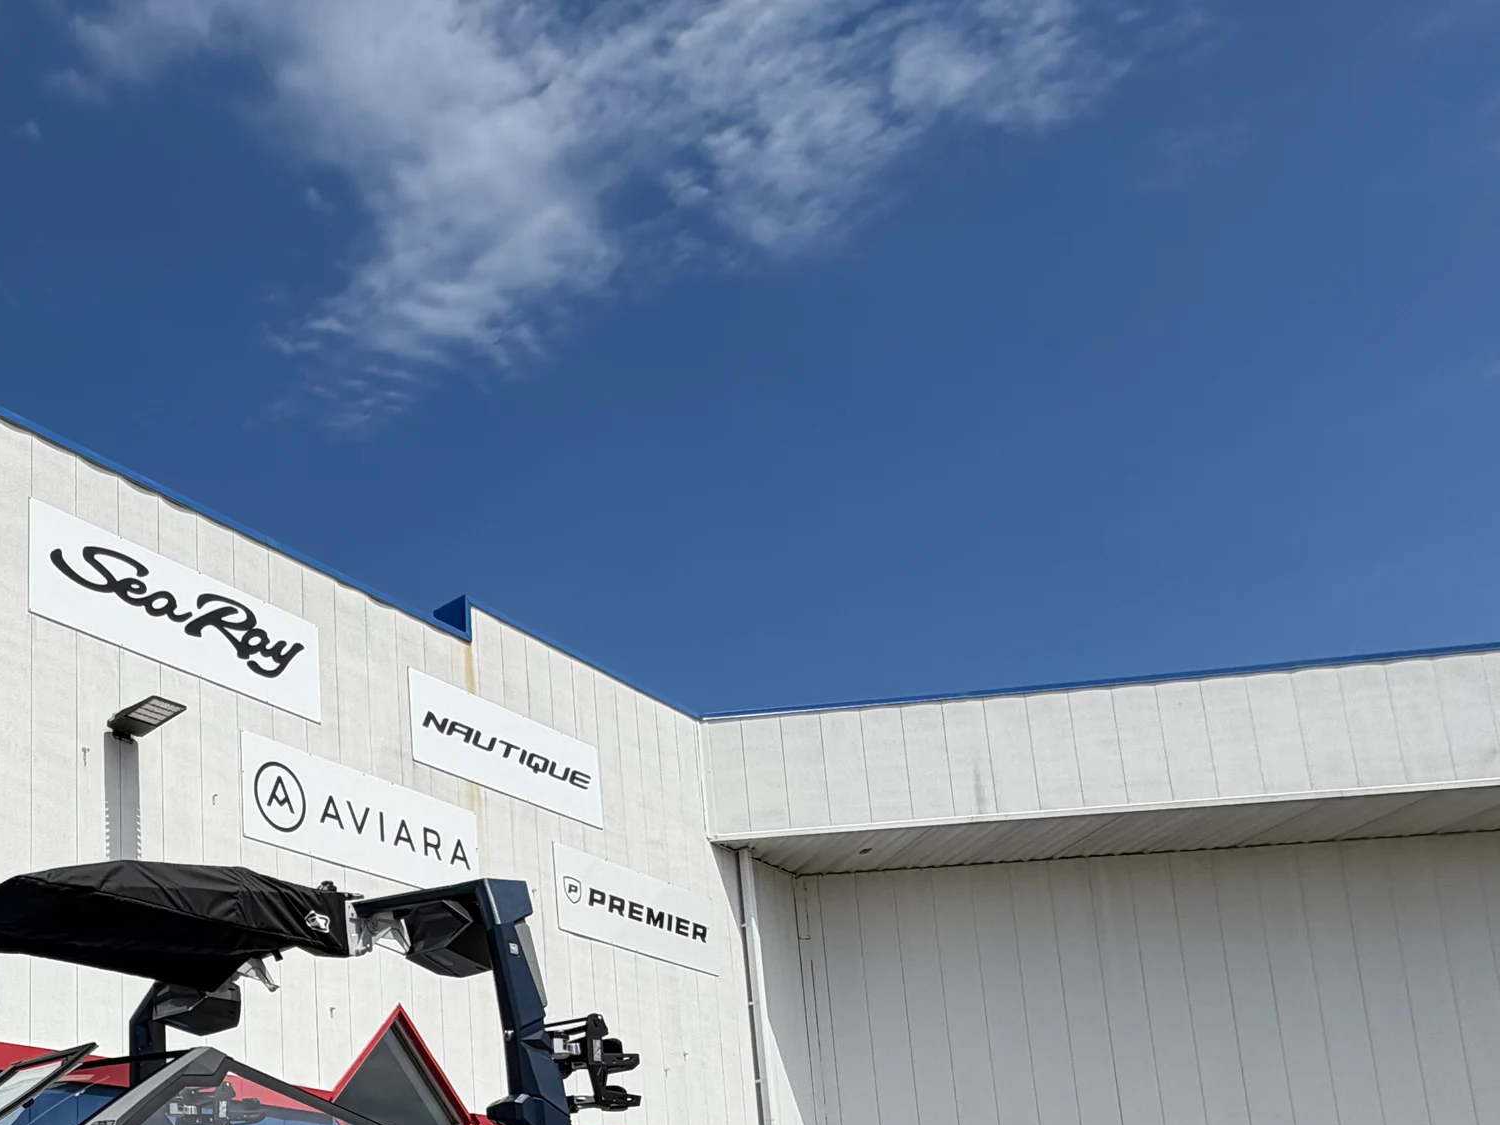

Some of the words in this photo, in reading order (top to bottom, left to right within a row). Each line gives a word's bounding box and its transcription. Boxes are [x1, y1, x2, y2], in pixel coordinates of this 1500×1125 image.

[50, 546, 193, 623] Sea
[184, 593, 305, 679] Ray
[422, 711, 591, 790] NAUTIQUE
[320, 795, 471, 871] AVIARA
[588, 887, 708, 944] PREMIER
